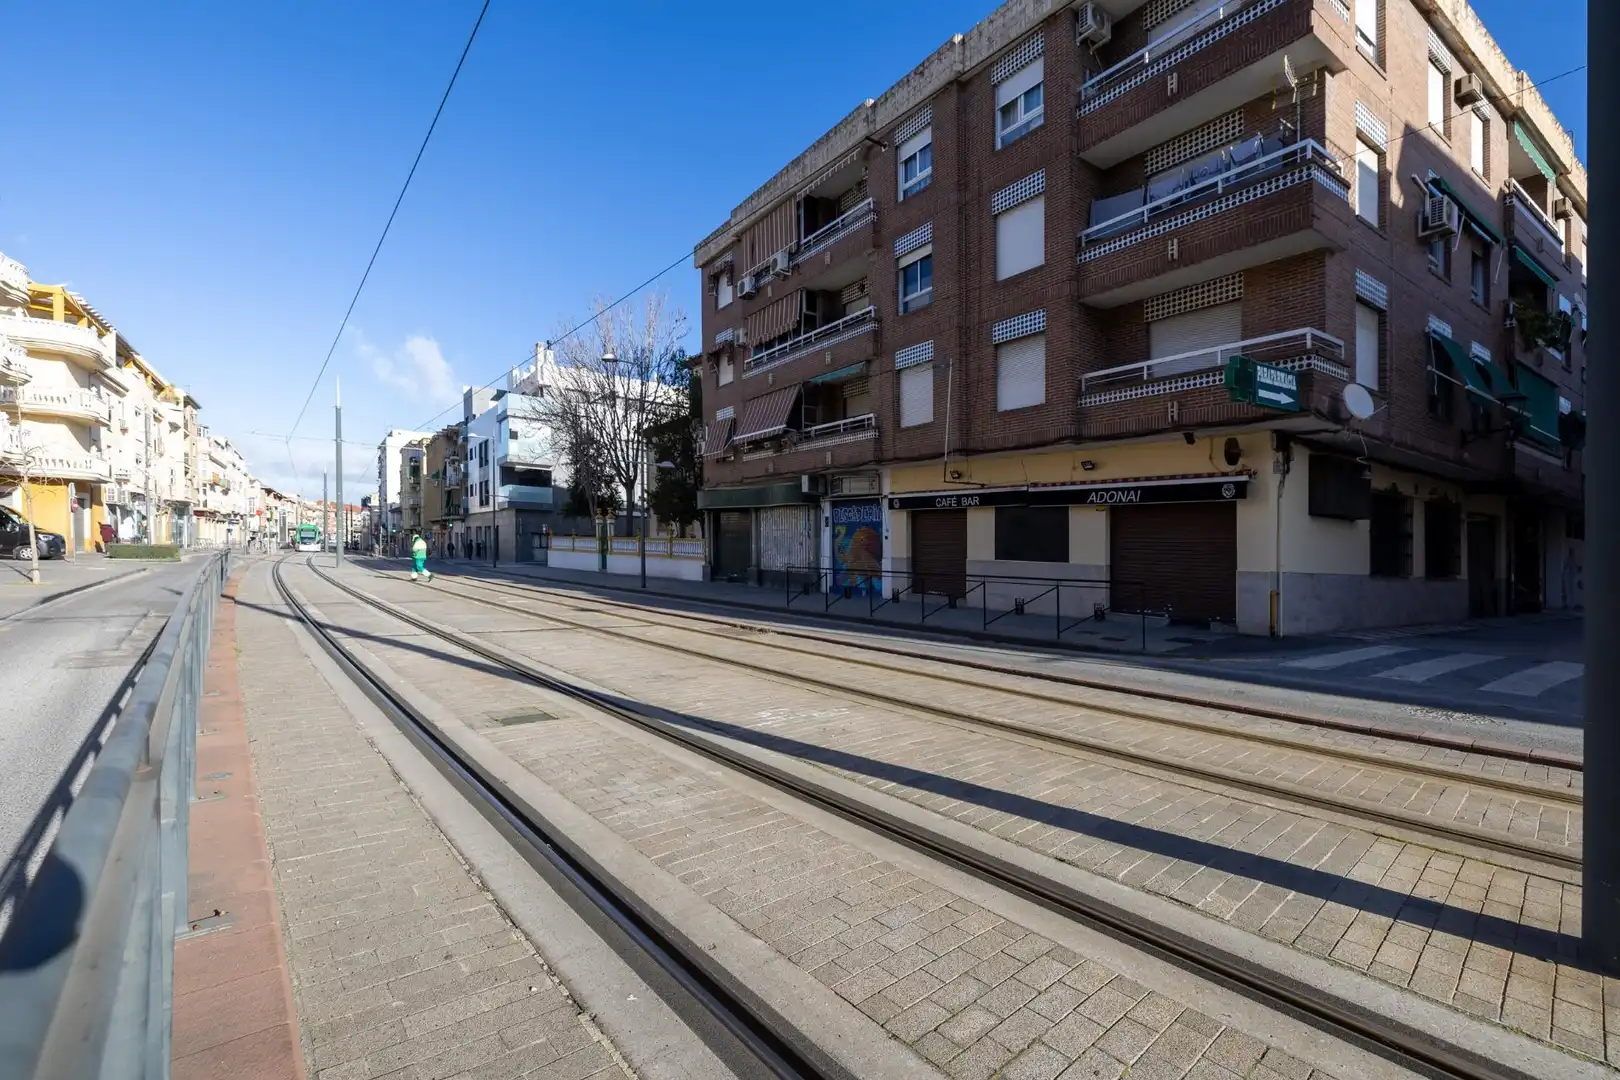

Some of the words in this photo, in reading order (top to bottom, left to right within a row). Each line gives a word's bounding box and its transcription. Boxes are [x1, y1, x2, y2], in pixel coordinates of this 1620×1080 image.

[935, 495, 957, 507] CAFÉ
[961, 496, 980, 507] BAR
[1086, 490, 1141, 504] ADONAI
